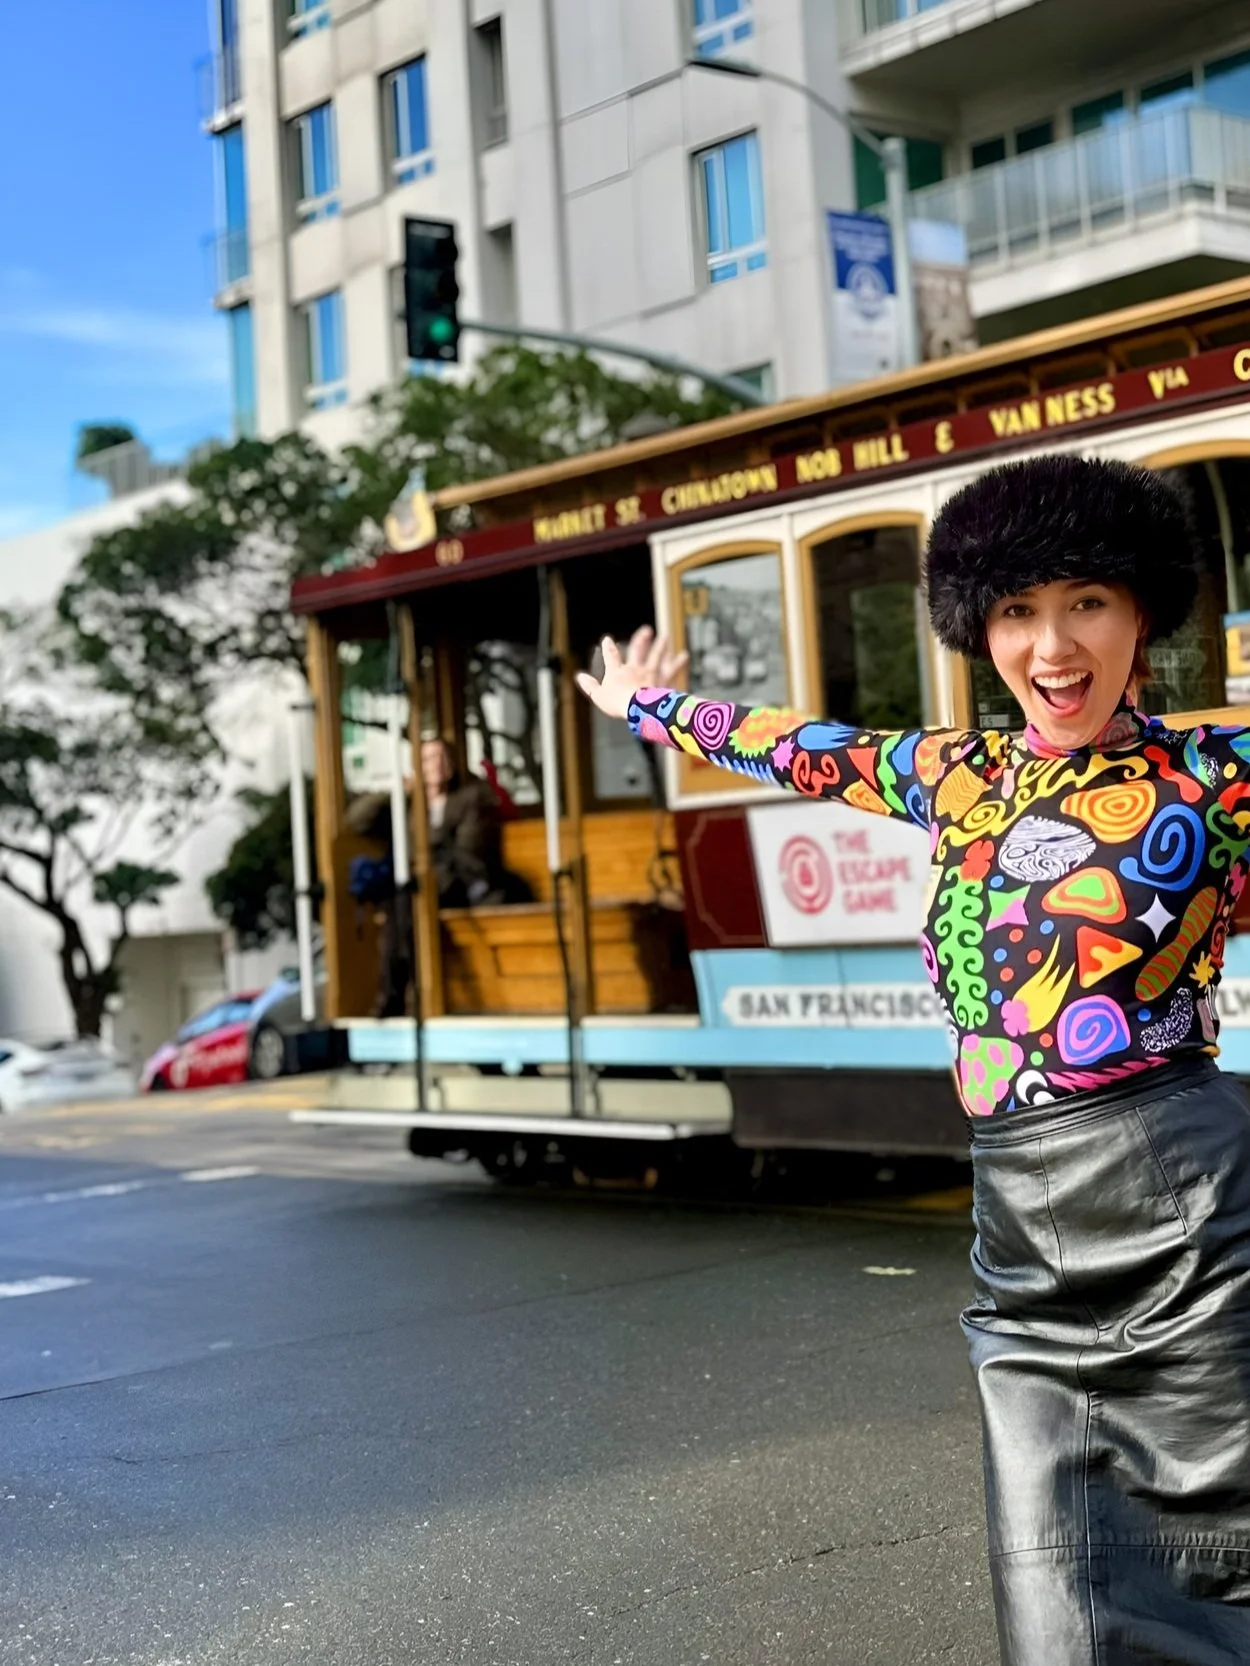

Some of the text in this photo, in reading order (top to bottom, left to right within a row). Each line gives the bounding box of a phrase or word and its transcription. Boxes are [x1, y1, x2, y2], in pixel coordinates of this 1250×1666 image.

[661, 463, 777, 515] CHINATOWN
[795, 447, 842, 483] NOB
[852, 433, 909, 471] HILL
[989, 400, 1041, 437] VAN
[1045, 382, 1116, 426] NESS
[833, 830, 871, 854] THE
[838, 857, 912, 885] ESCAPE
[843, 889, 898, 914] GAME
[739, 993, 790, 1019] SAN
